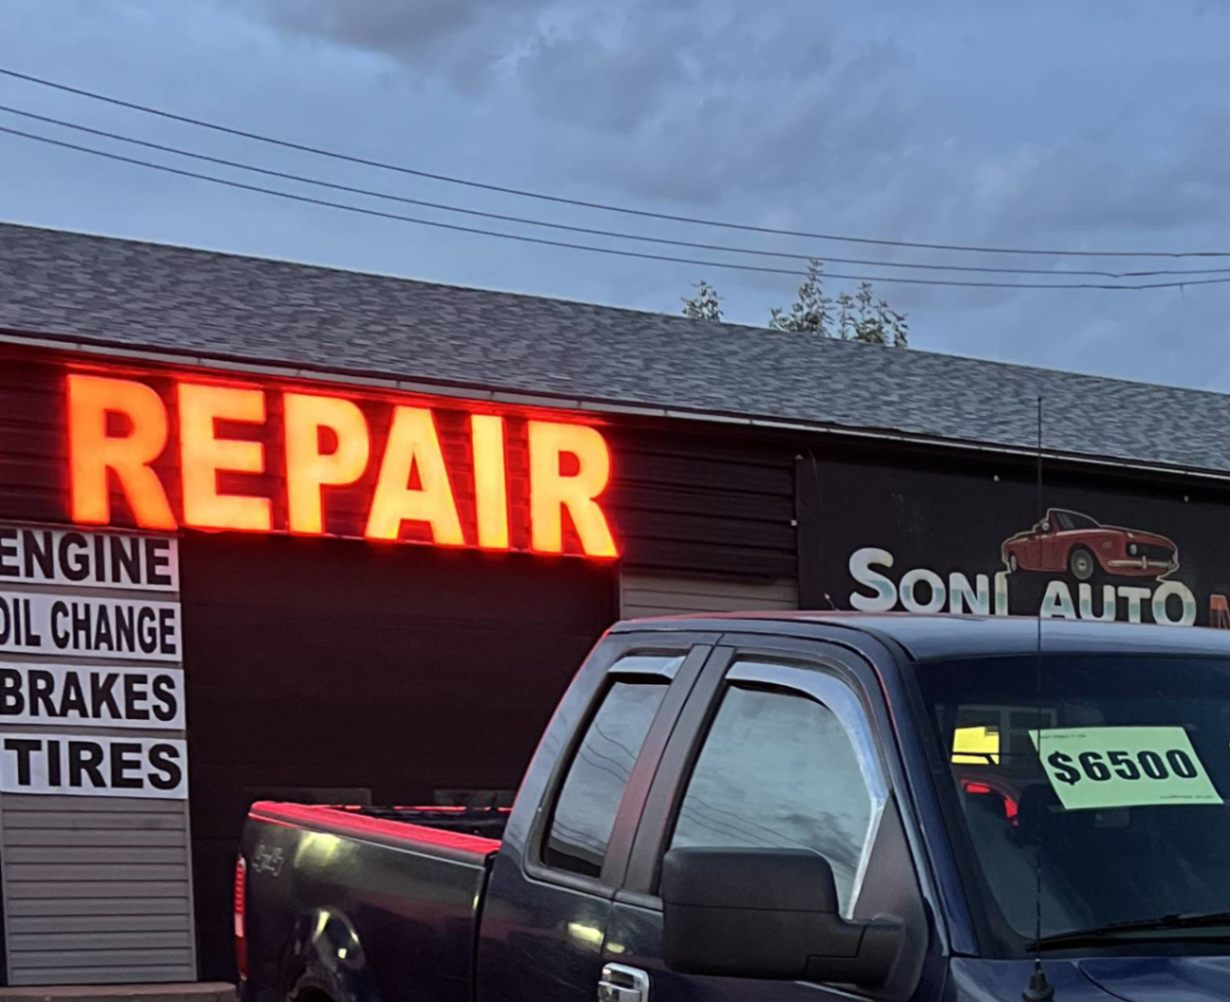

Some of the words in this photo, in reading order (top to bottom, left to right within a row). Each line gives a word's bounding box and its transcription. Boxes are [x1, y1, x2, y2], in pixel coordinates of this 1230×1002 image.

[66, 373, 618, 557] REPAIR
[0, 528, 172, 586] ENGINE
[849, 547, 1008, 617] SONI
[1040, 580, 1197, 627] AUTO
[51, 600, 177, 655] CHANGE
[0, 668, 177, 722] BRAKES
[4, 738, 182, 790] TIRES
[1047, 749, 1198, 786] $6500
